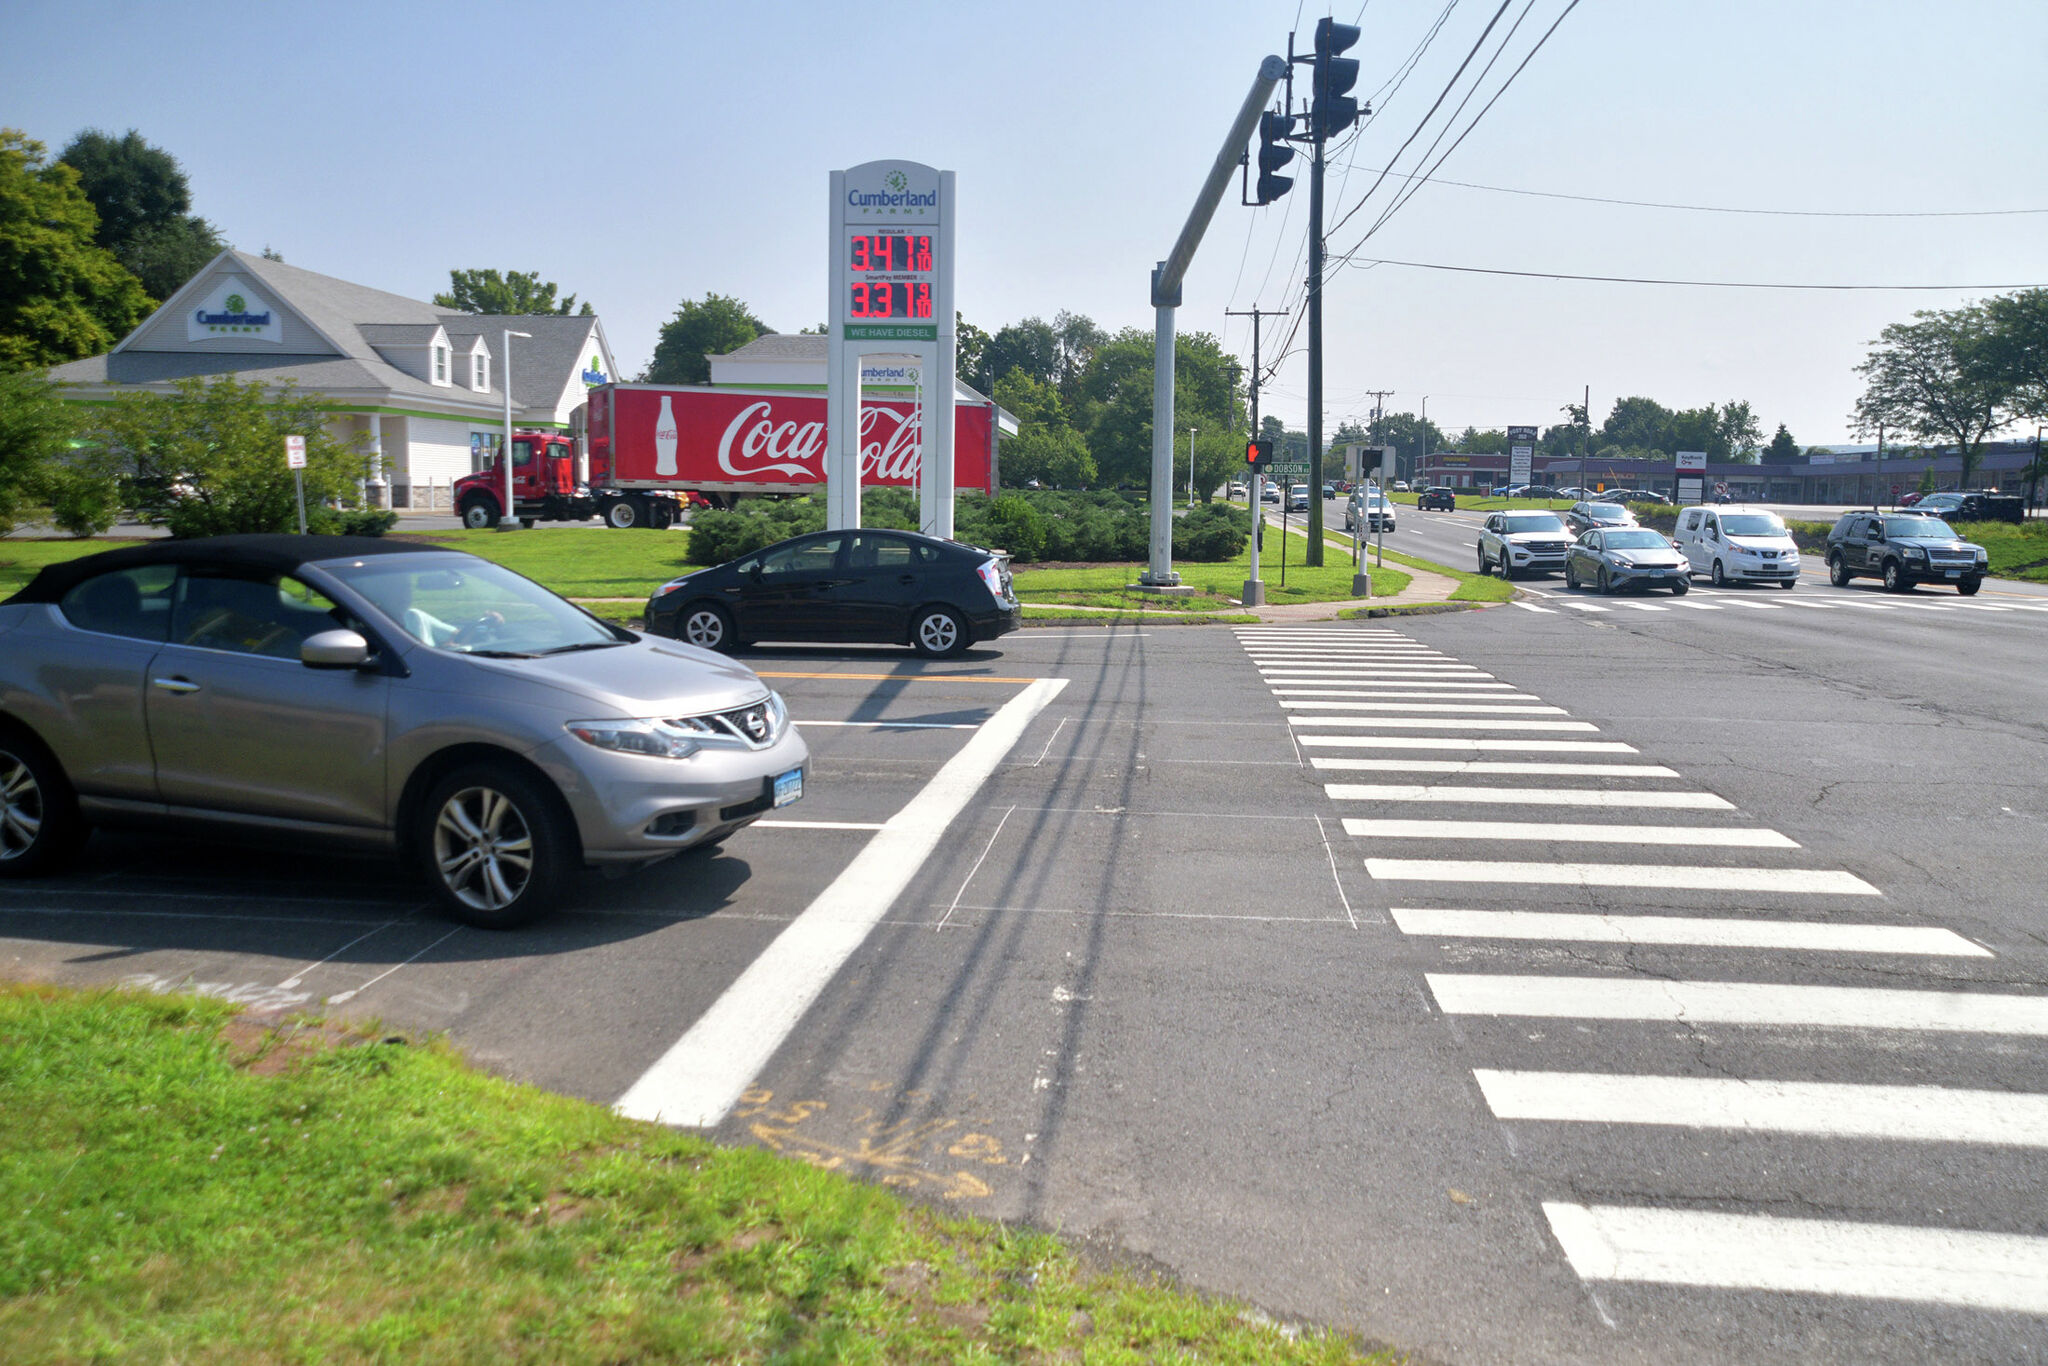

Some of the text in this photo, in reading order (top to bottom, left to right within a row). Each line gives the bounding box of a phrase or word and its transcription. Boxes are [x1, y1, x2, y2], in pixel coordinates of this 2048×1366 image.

[848, 189, 936, 207] Cumberland
[851, 328, 931, 337] WE HAVE DIESEL
[861, 367, 904, 377] umberland
[1274, 464, 1302, 473] DOBSON
